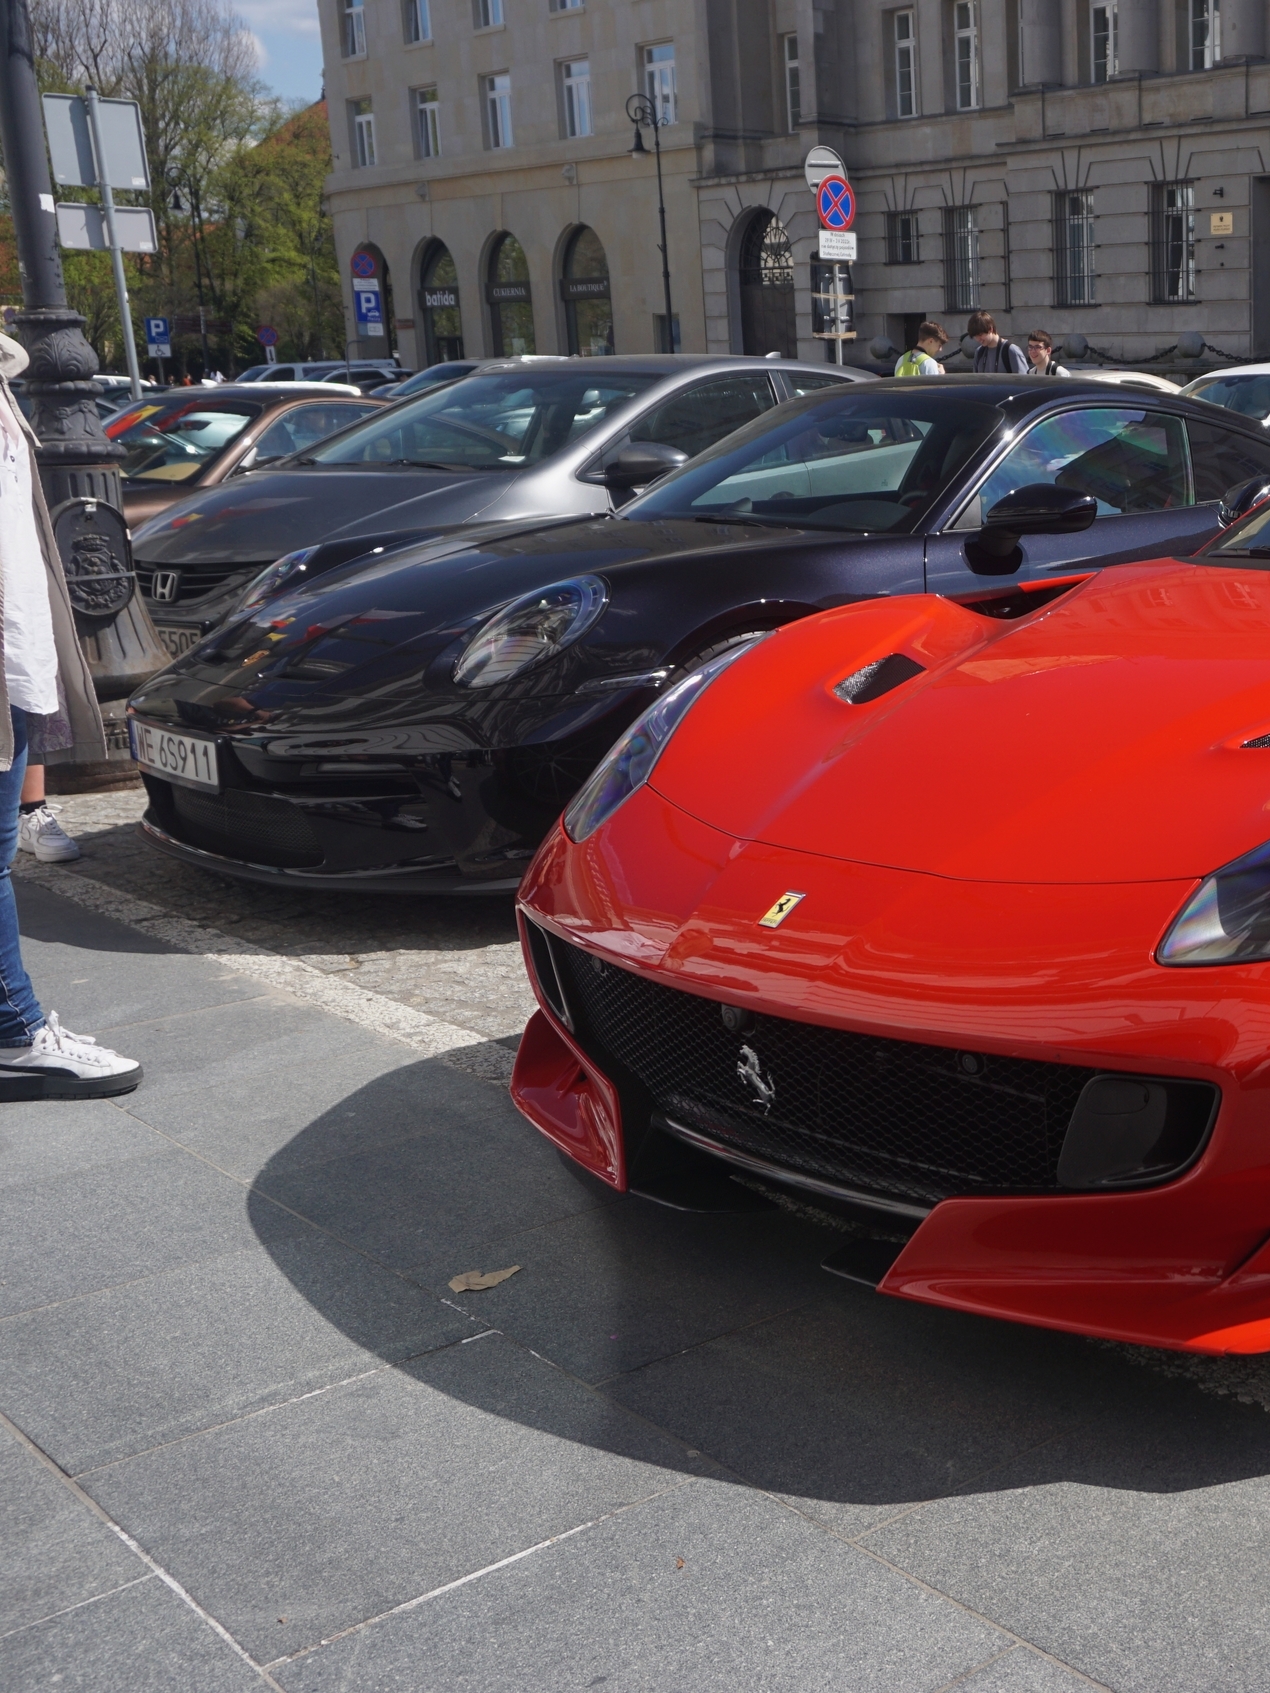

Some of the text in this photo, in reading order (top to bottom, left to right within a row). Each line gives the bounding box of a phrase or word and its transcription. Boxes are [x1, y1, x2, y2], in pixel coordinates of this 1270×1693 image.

[493, 287, 525, 297] CUKIERNIA
[577, 283, 604, 292] BOUTIQUE
[360, 292, 376, 313] P
[425, 291, 455, 306] batida
[150, 319, 164, 336] P
[136, 724, 212, 781] WE 6S911
